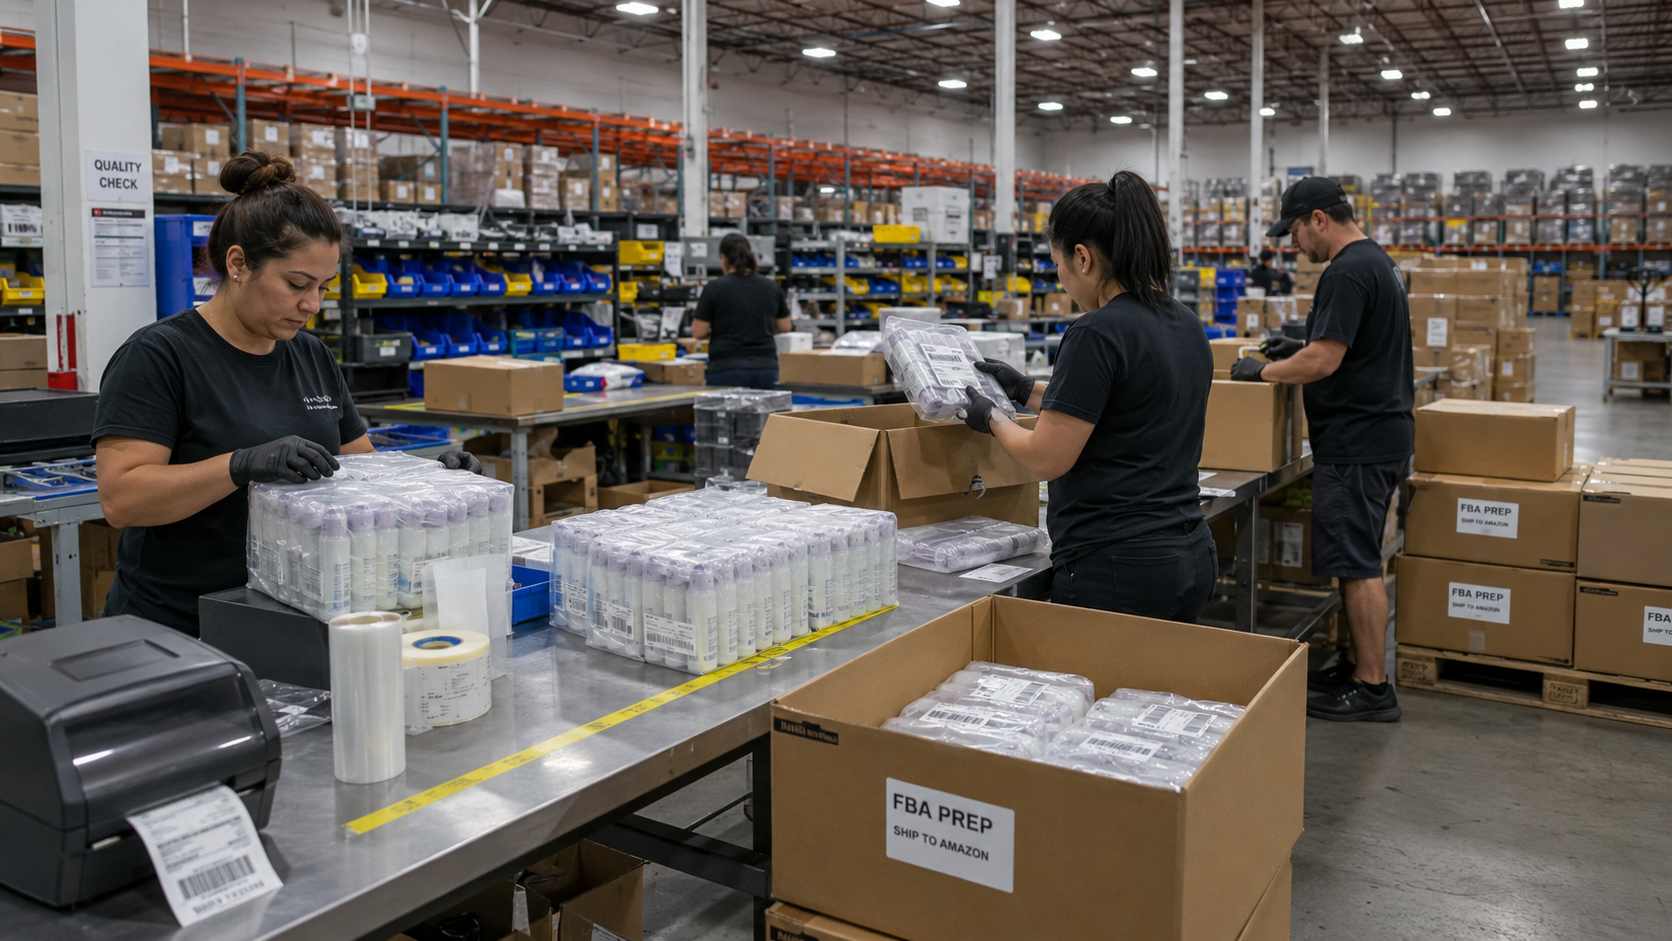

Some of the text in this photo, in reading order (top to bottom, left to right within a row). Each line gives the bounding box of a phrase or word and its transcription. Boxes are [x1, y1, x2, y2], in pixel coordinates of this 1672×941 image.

[94, 159, 142, 173] QUALITY
[99, 177, 138, 190] CHECK
[1460, 503, 1512, 516] FBA PREP
[1452, 588, 1504, 602] FBA PREP
[1647, 612, 1671, 623] FBA
[893, 792, 993, 834] FBA PREP
[893, 825, 989, 861] SHIP TO AMAZON
